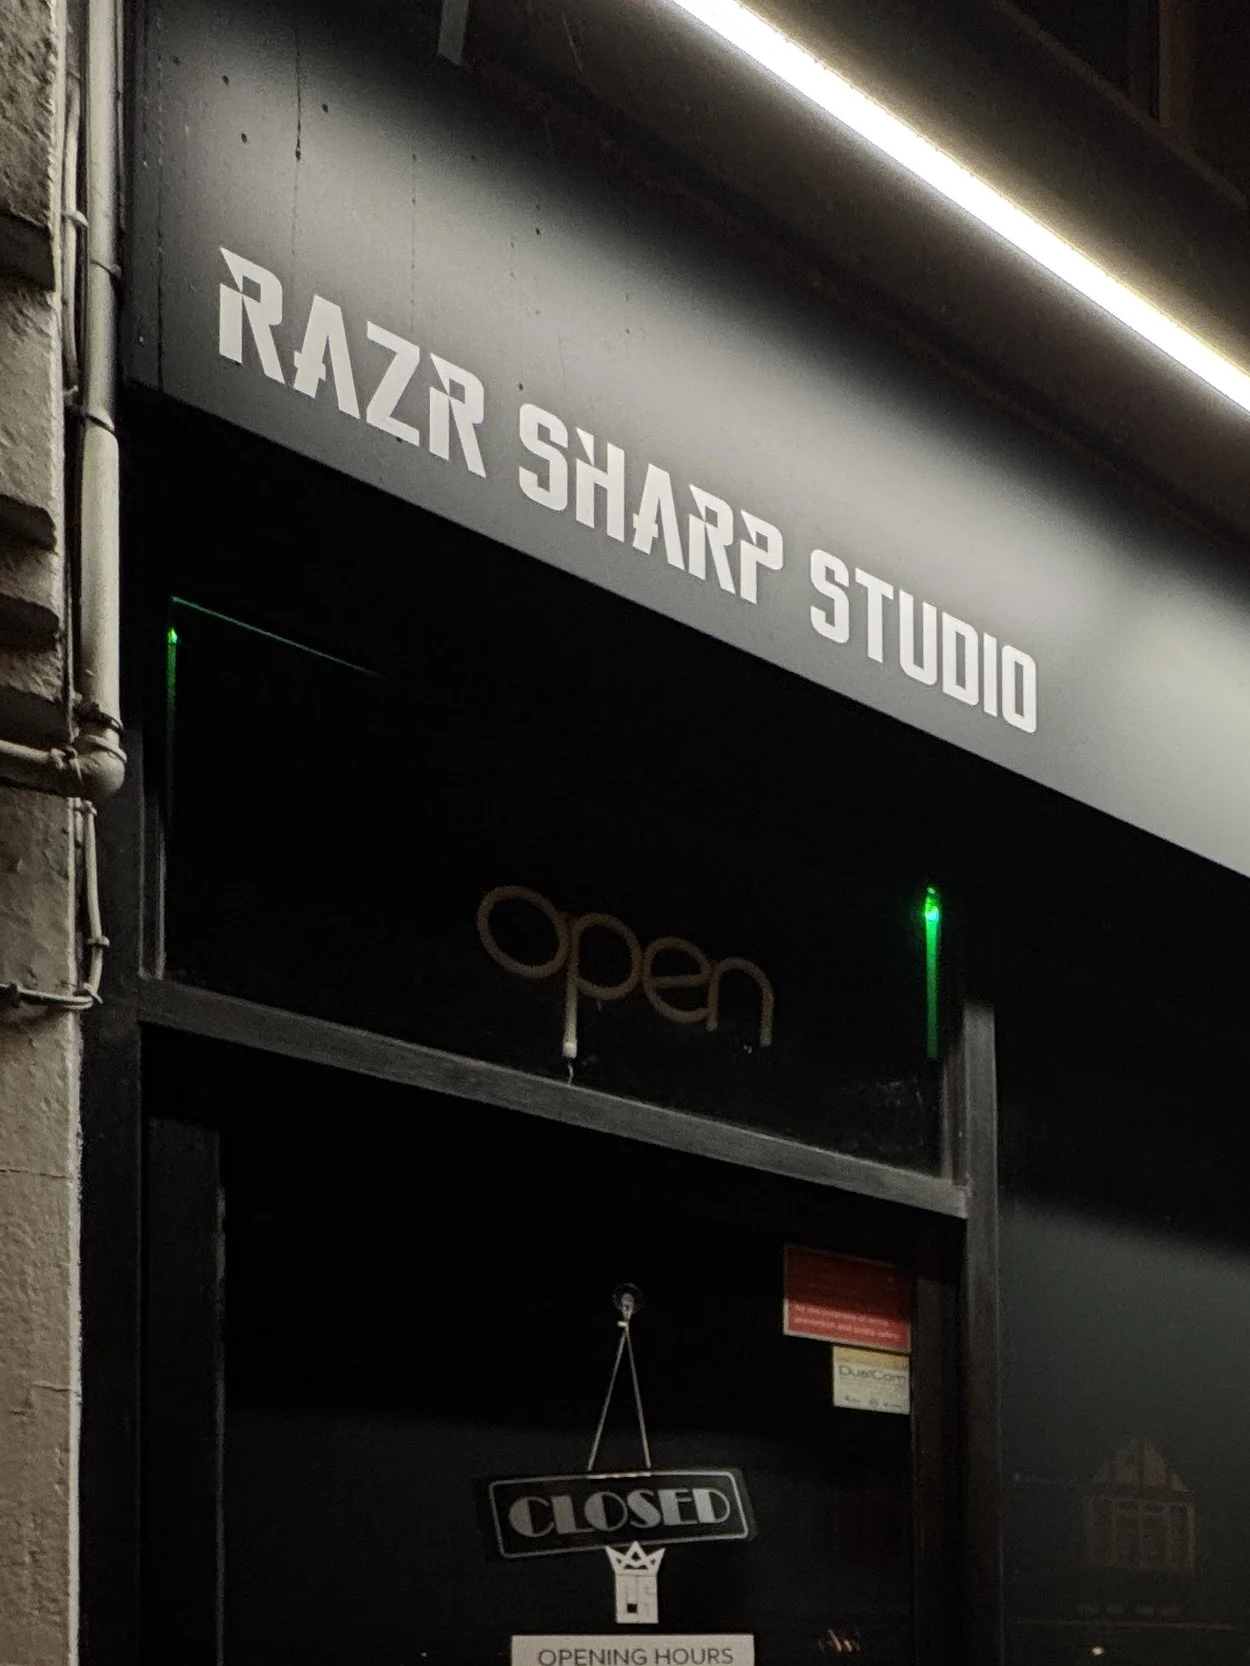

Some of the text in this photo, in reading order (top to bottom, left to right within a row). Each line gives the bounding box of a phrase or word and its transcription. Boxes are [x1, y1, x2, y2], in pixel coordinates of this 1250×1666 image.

[219, 246, 1037, 733] RAZR SHARP STUDIO
[476, 883, 775, 1058] open
[509, 1488, 731, 1537] CLOSED
[537, 1647, 734, 1666] OPENING HOURS
